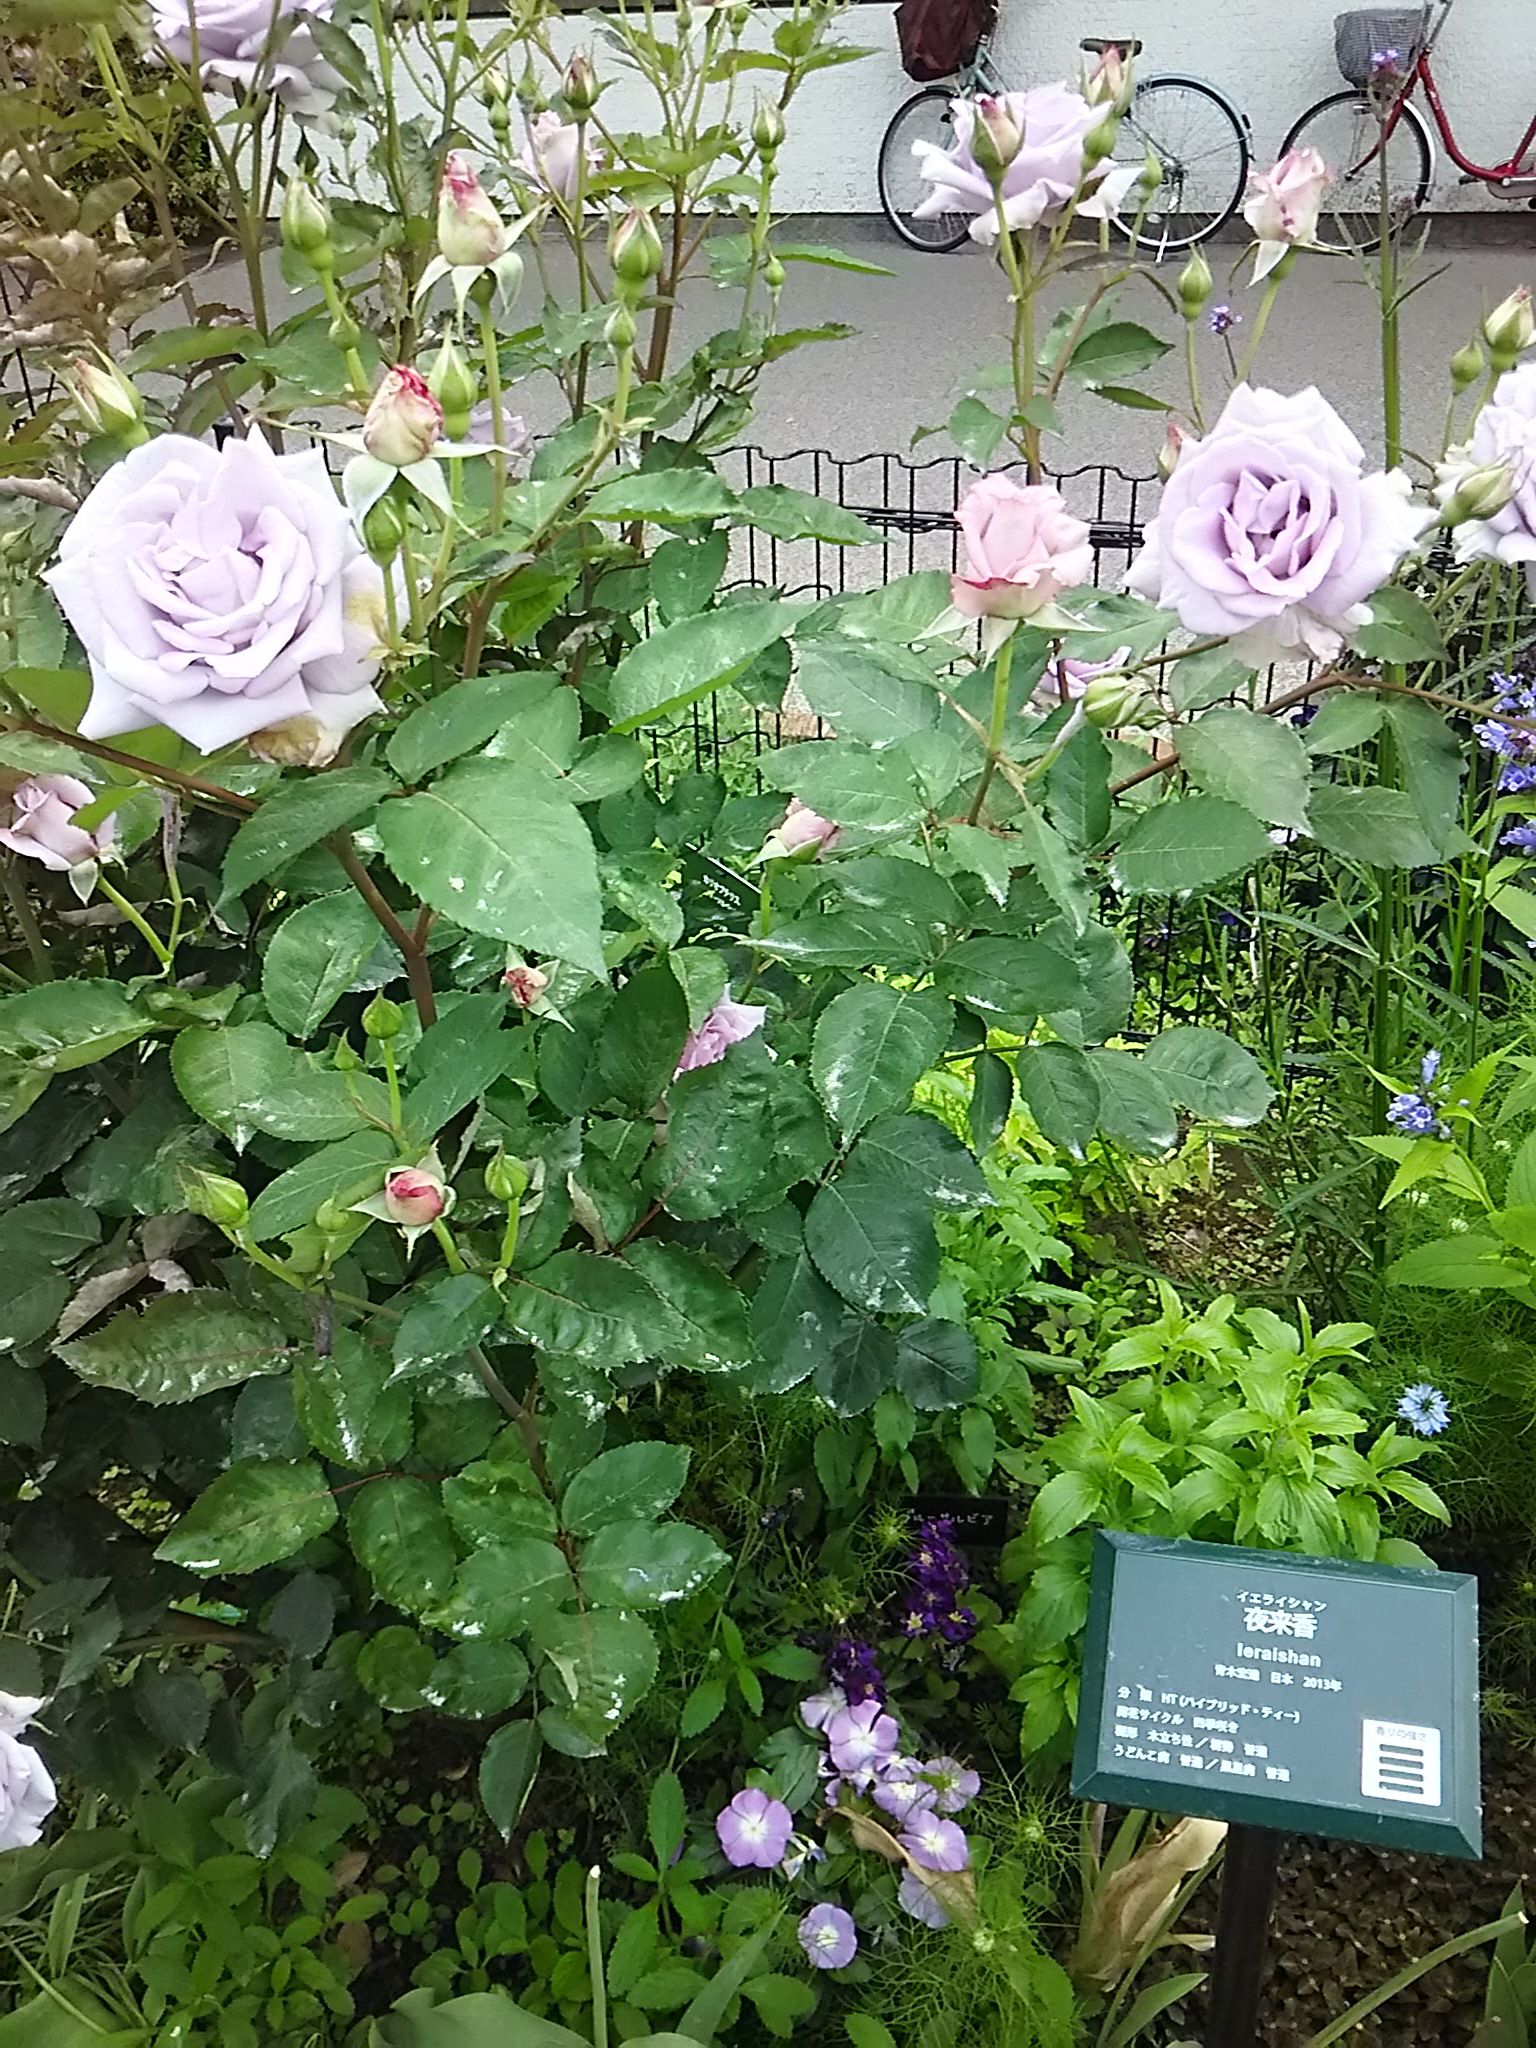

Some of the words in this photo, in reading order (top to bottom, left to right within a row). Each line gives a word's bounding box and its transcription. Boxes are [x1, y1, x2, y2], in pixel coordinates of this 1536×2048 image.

[1236, 1591, 1327, 1612] イエライシャン
[1243, 1606, 1318, 1640] 夜来香
[1270, 1671, 1294, 1685] 日本
[1302, 1676, 1343, 1692] 2013年
